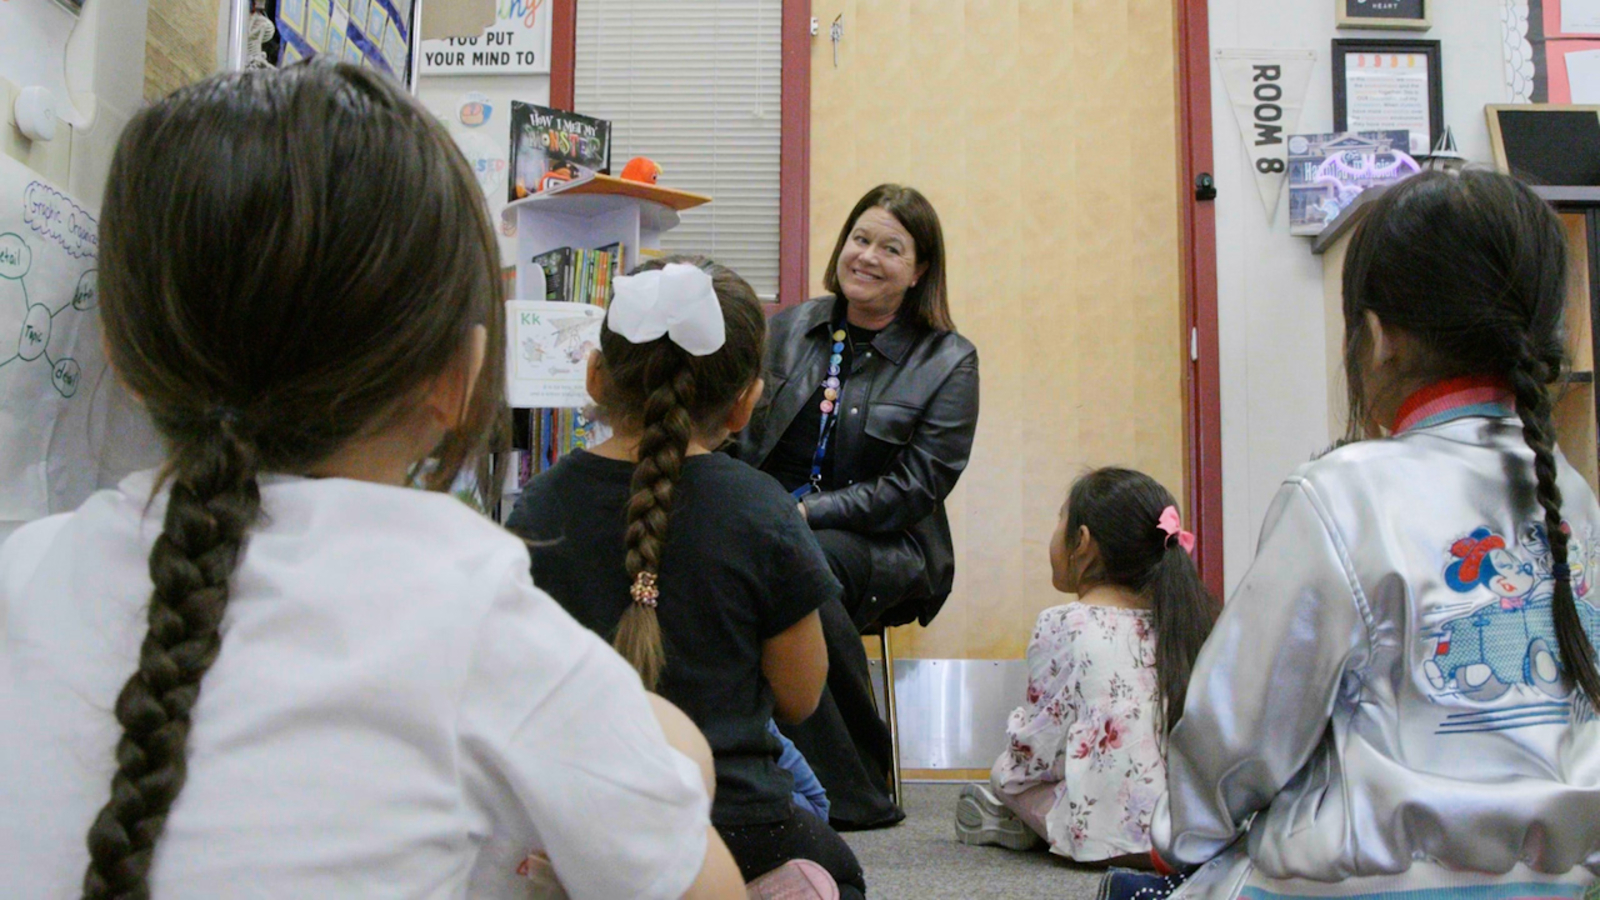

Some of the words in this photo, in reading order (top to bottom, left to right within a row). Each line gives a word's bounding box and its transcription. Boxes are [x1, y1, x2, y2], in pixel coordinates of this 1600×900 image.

[487, 32, 514, 46] PUT
[425, 51, 465, 66] YOUR
[472, 51, 510, 66] MIND
[516, 51, 535, 66] TO
[1252, 64, 1282, 146] ROOM
[525, 125, 602, 158] MONSTER
[1255, 158, 1285, 174] 8
[520, 312, 541, 326] Kk
